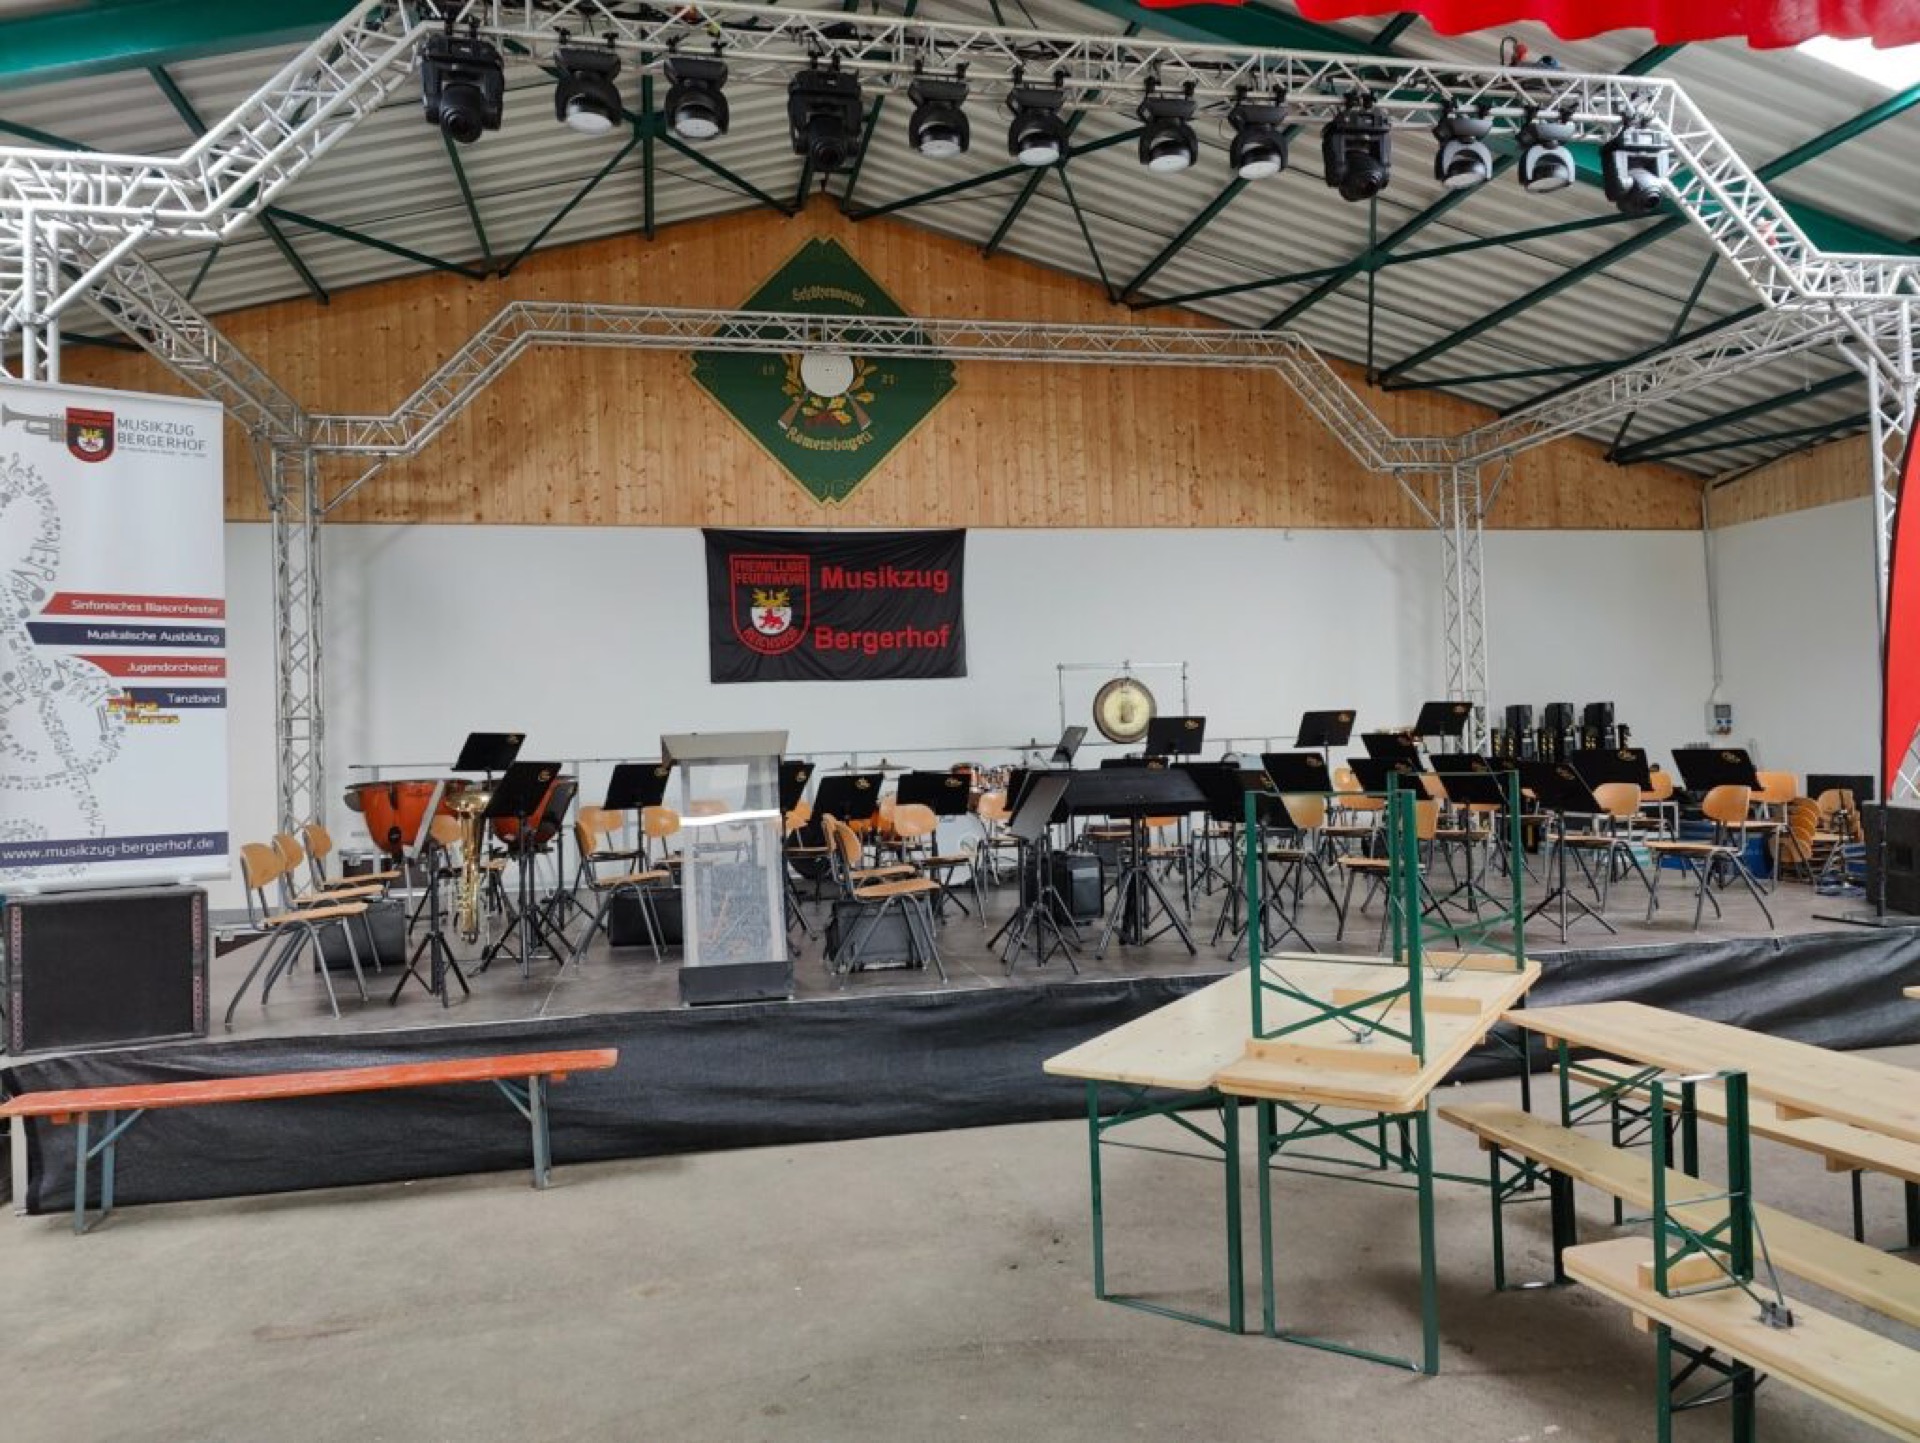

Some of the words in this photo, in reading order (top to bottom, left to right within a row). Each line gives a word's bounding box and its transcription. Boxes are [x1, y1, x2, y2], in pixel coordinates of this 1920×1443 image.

[118, 418, 194, 437] MUSIKZUG
[117, 432, 207, 451] BERGERHOF
[821, 566, 949, 593] Musikzug
[71, 599, 142, 612] Sinfonisches
[145, 602, 219, 615] Blasorchester
[87, 629, 156, 641] Musikalische
[160, 631, 219, 644] Ausbildung
[814, 625, 950, 654] Bergerhof
[127, 662, 219, 675] Jugendorchester
[167, 692, 220, 704] Tanzband
[2, 837, 214, 860] www.musikzug-bergerhof.de
